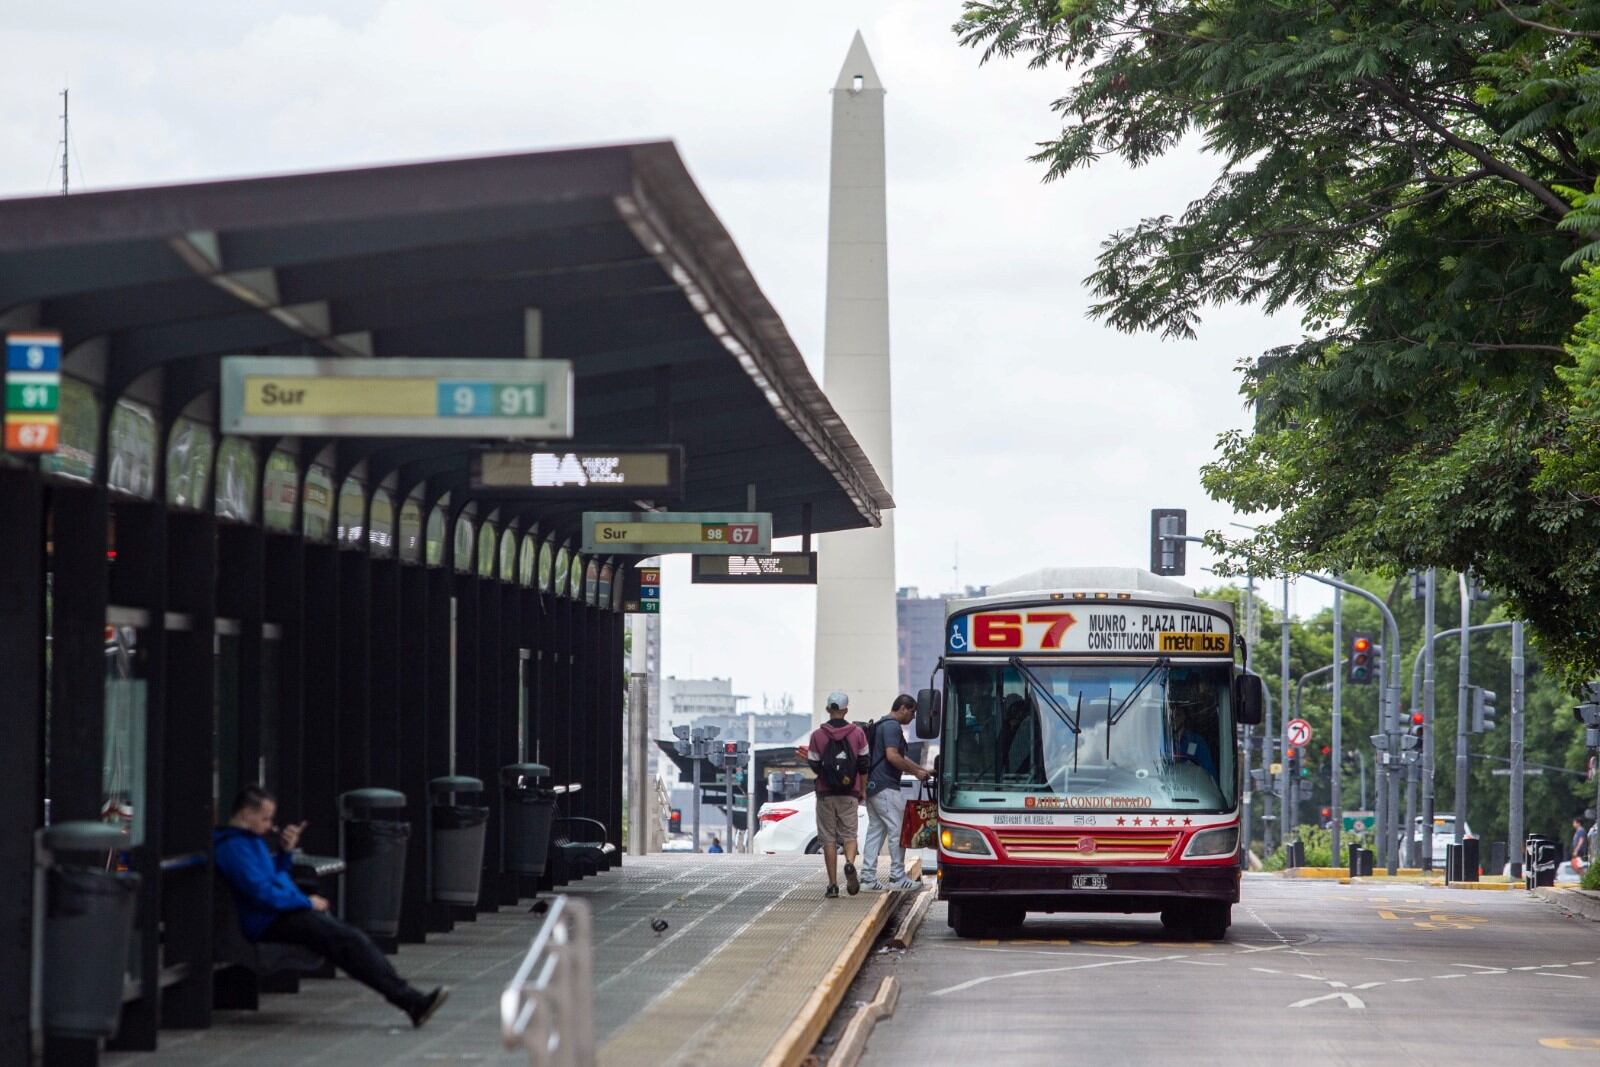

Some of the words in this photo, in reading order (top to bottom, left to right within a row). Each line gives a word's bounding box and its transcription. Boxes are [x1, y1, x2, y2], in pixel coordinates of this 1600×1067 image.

[26, 345, 44, 370] 9
[21, 385, 48, 409] 91
[261, 382, 306, 406] Sur
[453, 386, 475, 414] 9
[500, 386, 537, 414] 91
[17, 423, 48, 448] 67
[602, 527, 628, 540] Sur
[707, 528, 723, 540] 98
[732, 528, 753, 543] 67
[646, 573, 656, 582] 67
[648, 588, 655, 596] 9
[646, 603, 656, 611] 91
[972, 612, 1077, 649] 67
[1089, 614, 1126, 631] MUNRO
[1142, 615, 1176, 632] PLAZA
[1181, 615, 1213, 632] ITALIA
[1088, 632, 1155, 650] CONSTITUCION
[1036, 796, 1061, 808] AIRE
[1063, 796, 1152, 808] ACONDICIONADO
[1073, 815, 1097, 825] 54
